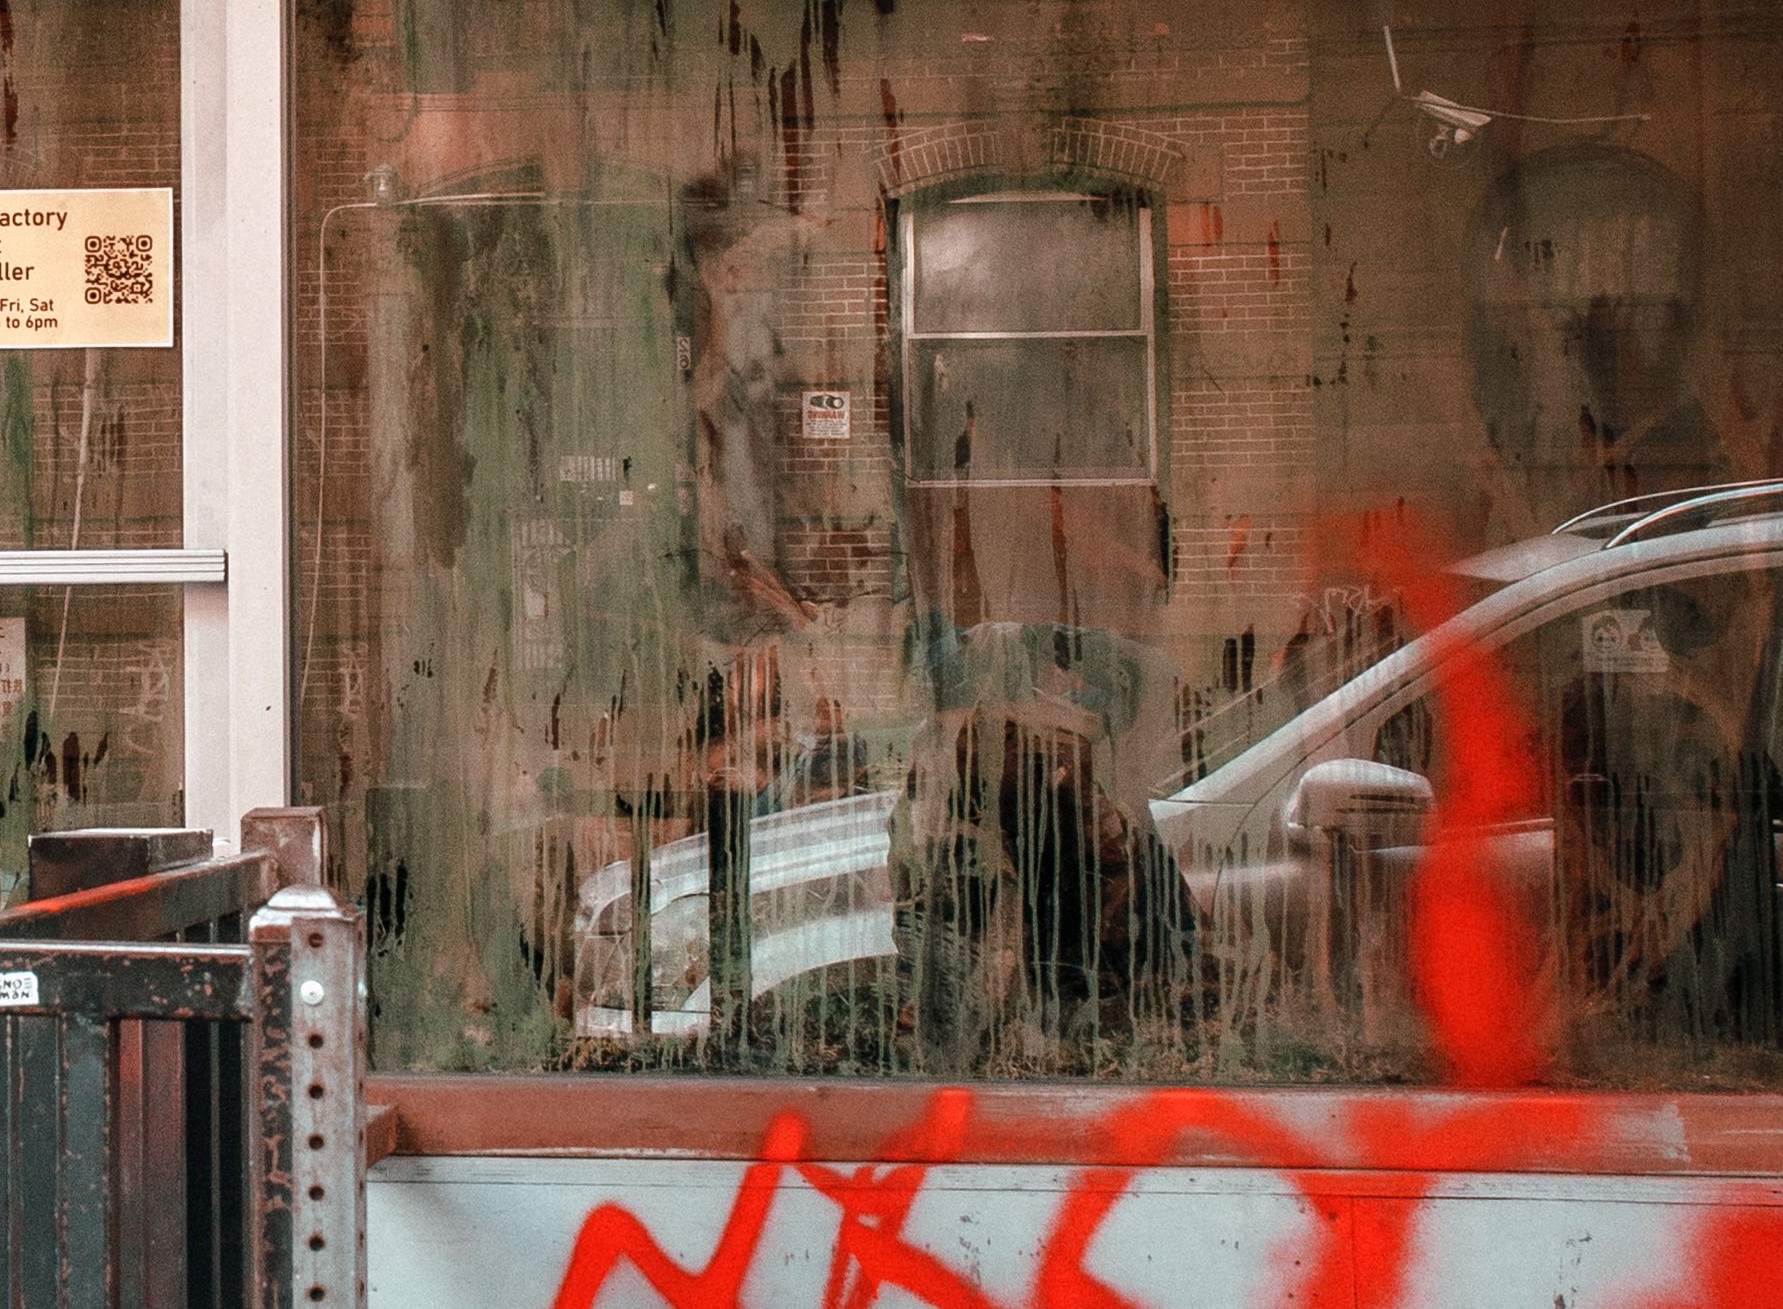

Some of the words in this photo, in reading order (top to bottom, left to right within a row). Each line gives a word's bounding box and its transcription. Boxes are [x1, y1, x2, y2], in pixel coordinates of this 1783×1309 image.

[0, 298, 24, 314] Fri,
[29, 298, 54, 312] Sat
[6, 316, 20, 329] to
[25, 315, 58, 331] 6pm
